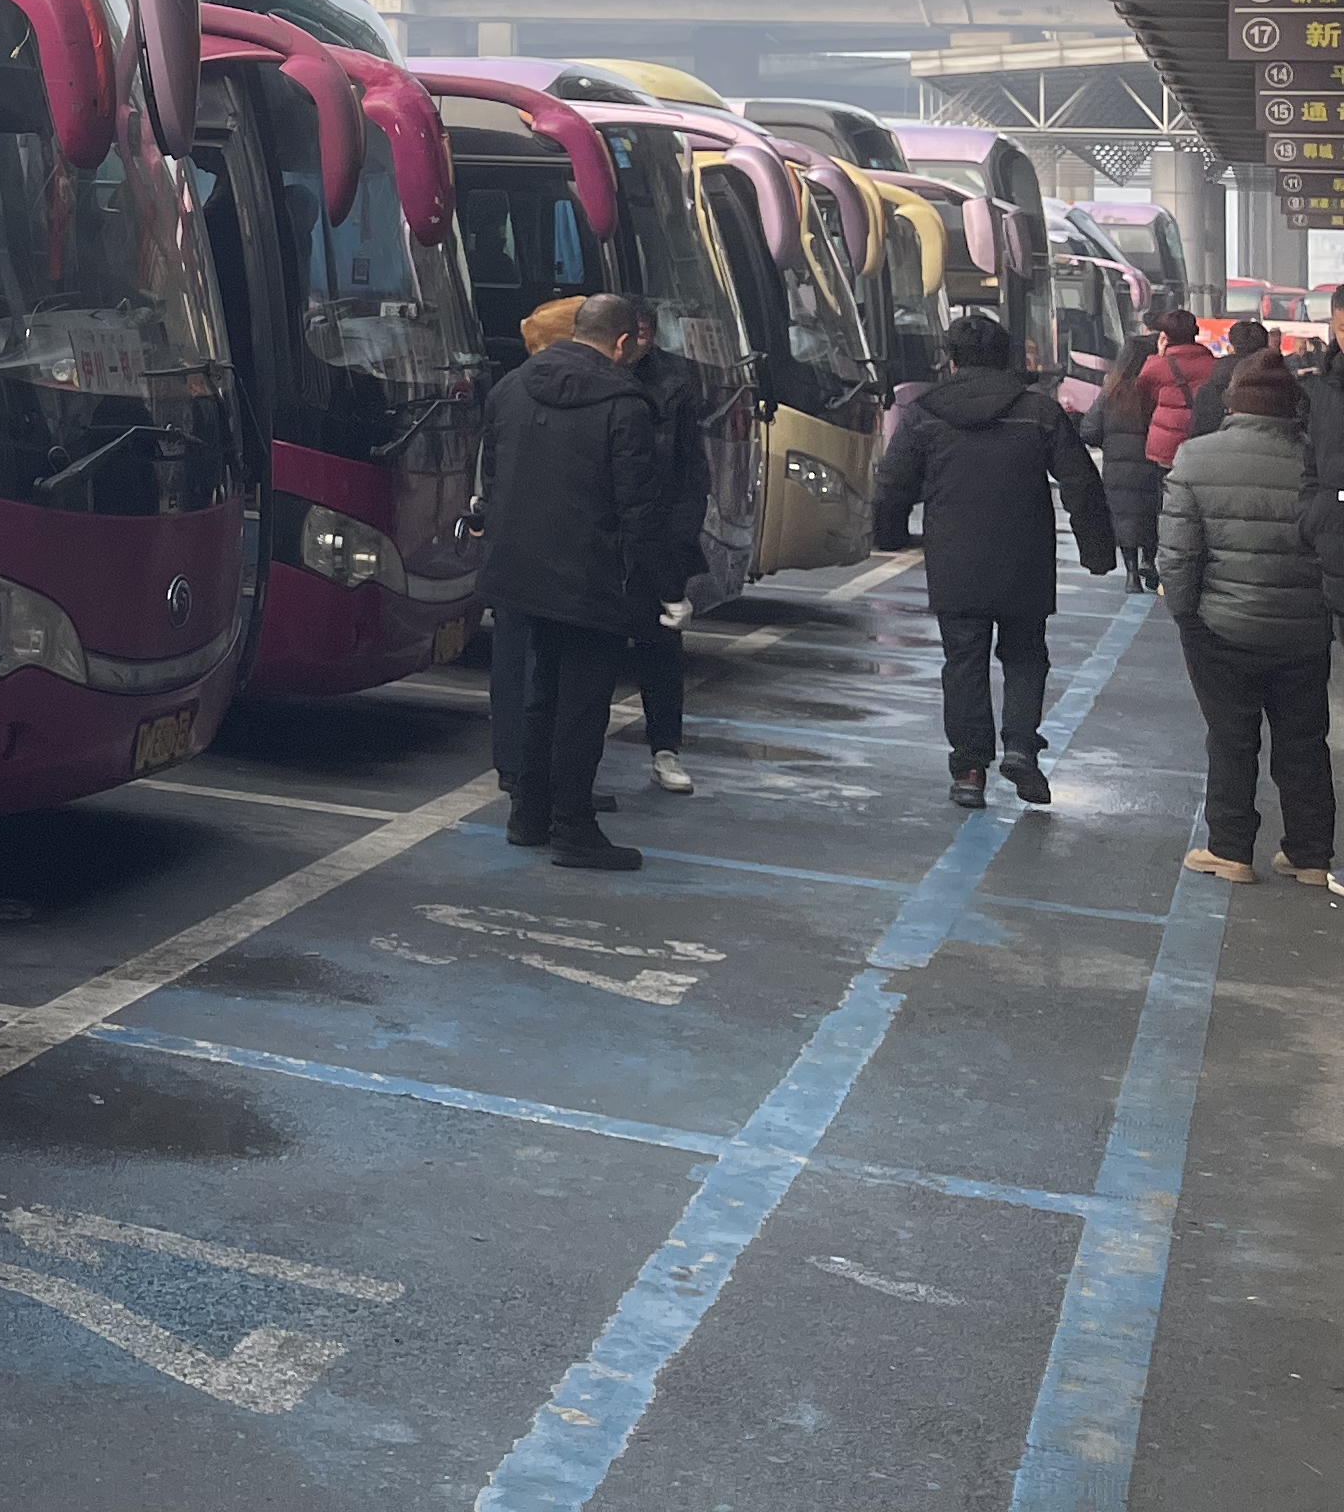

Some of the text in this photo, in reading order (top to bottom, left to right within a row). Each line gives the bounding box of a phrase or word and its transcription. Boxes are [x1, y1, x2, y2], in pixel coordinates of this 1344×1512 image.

[1250, 21, 1341, 47] 17 新
[1270, 67, 1288, 82] 14
[1271, 104, 1289, 119] 15
